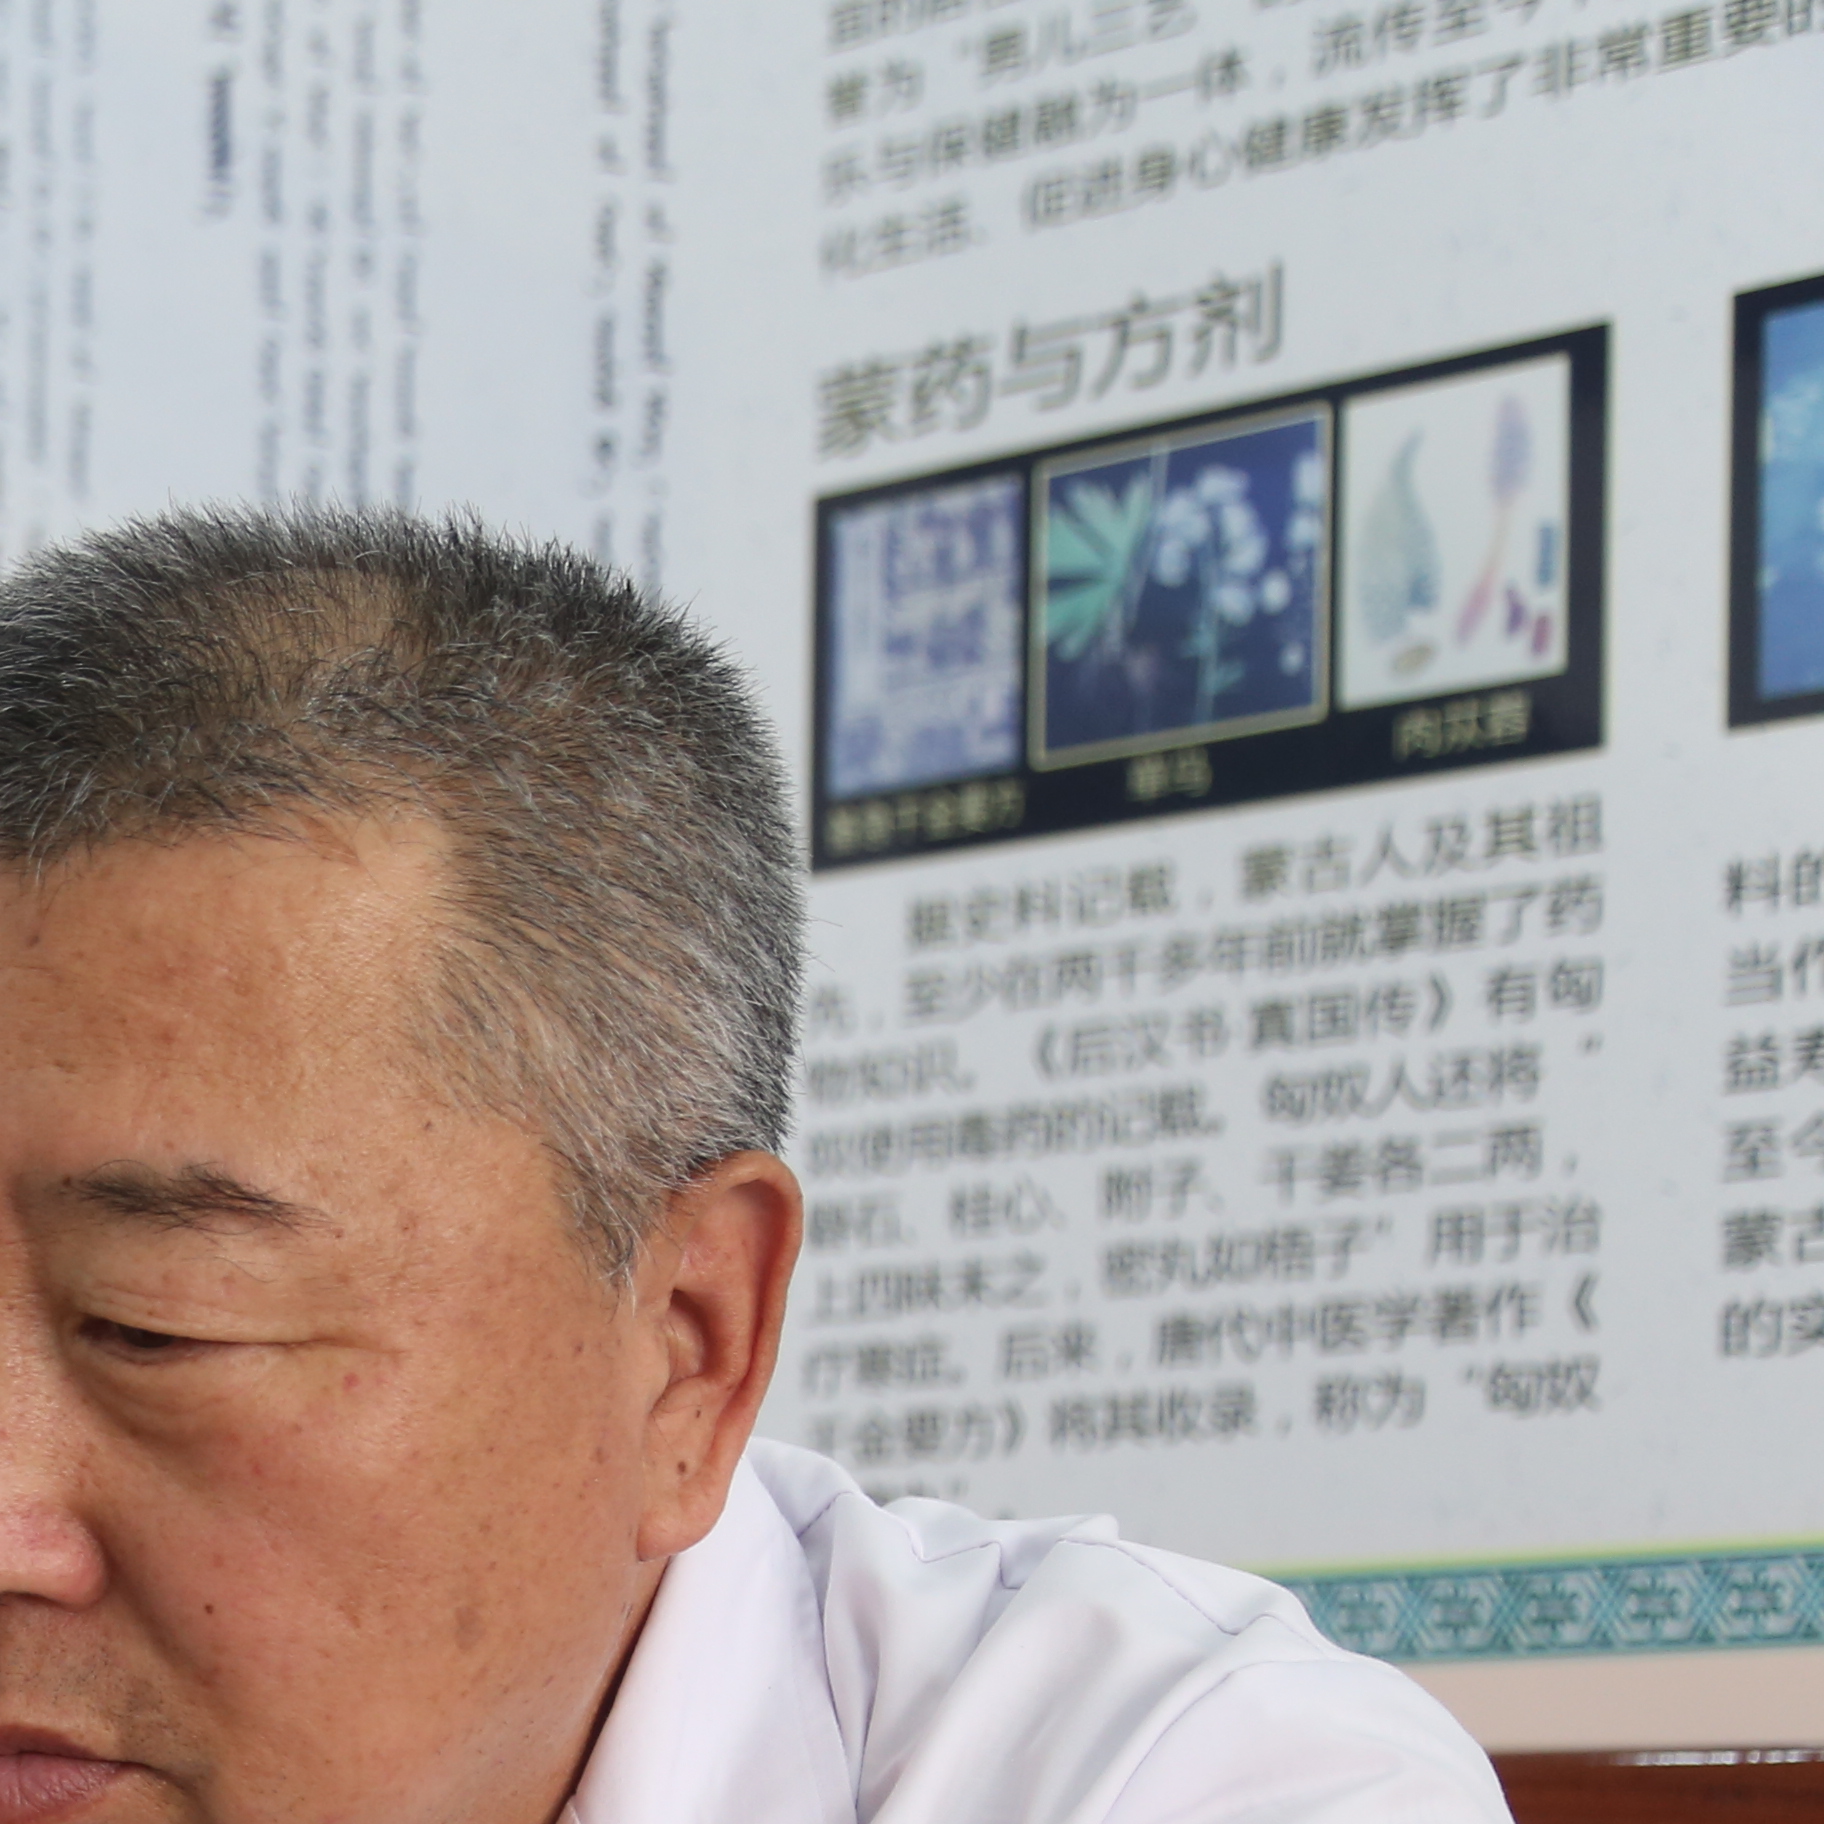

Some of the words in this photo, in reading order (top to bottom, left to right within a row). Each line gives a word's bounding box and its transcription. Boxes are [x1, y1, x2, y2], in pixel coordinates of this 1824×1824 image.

[815, 261, 1285, 462] 蒙药与方剂
